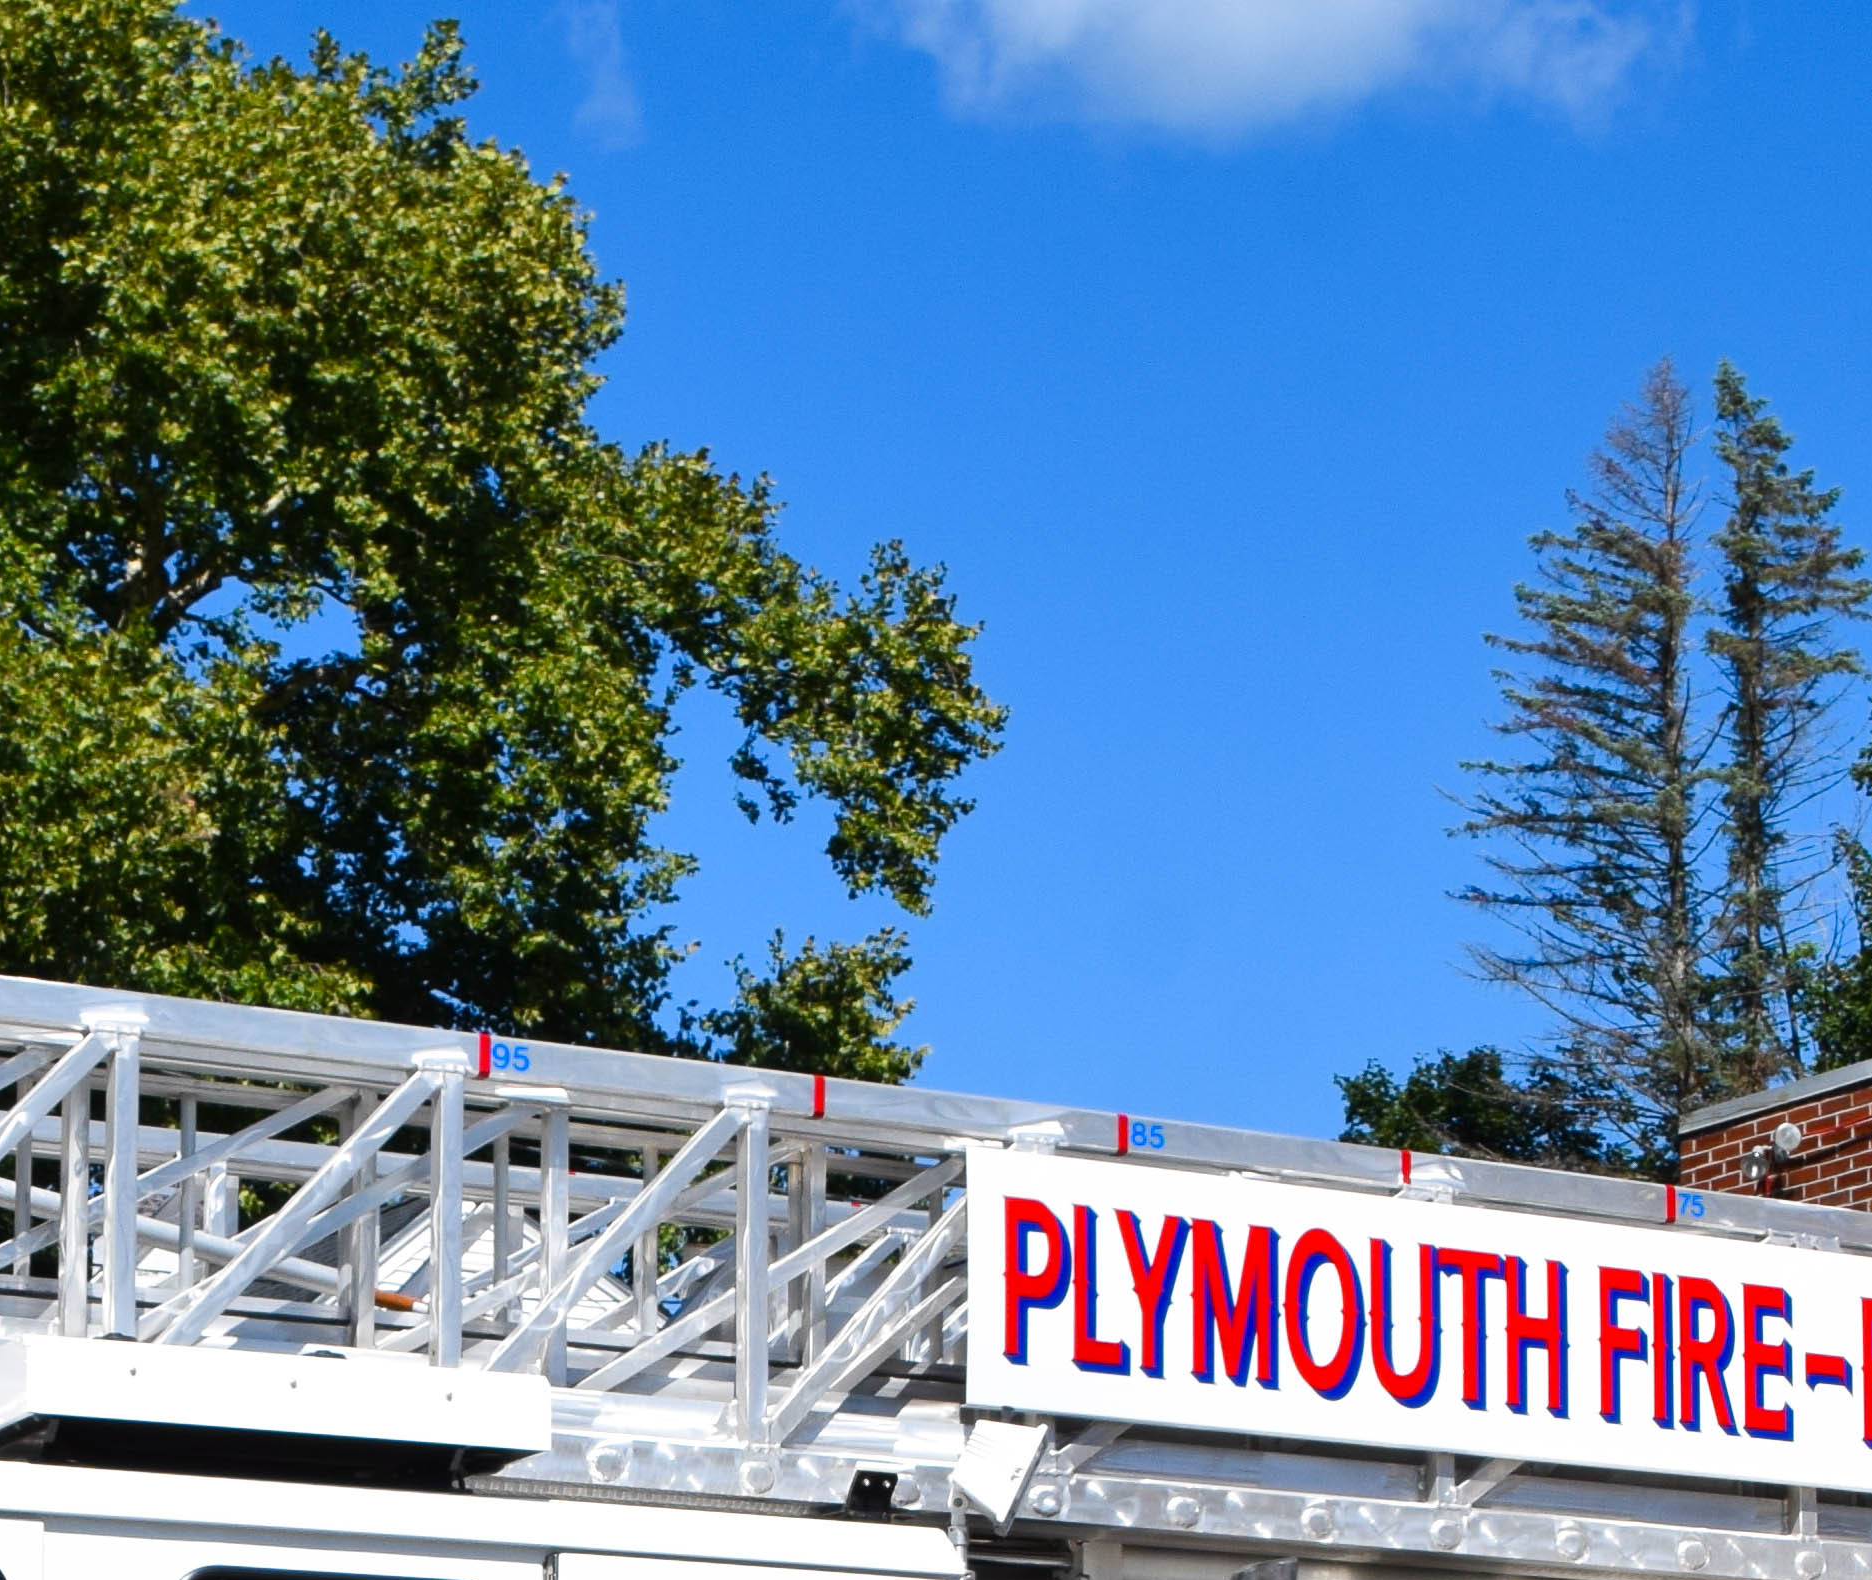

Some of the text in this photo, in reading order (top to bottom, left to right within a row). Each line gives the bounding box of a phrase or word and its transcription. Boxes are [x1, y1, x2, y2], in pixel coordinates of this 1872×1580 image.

[492, 1043, 530, 1072] 95
[1131, 1122, 1165, 1149] 85
[1679, 1193, 1706, 1218] 75
[1002, 1197, 1570, 1420] PLYMOUTH
